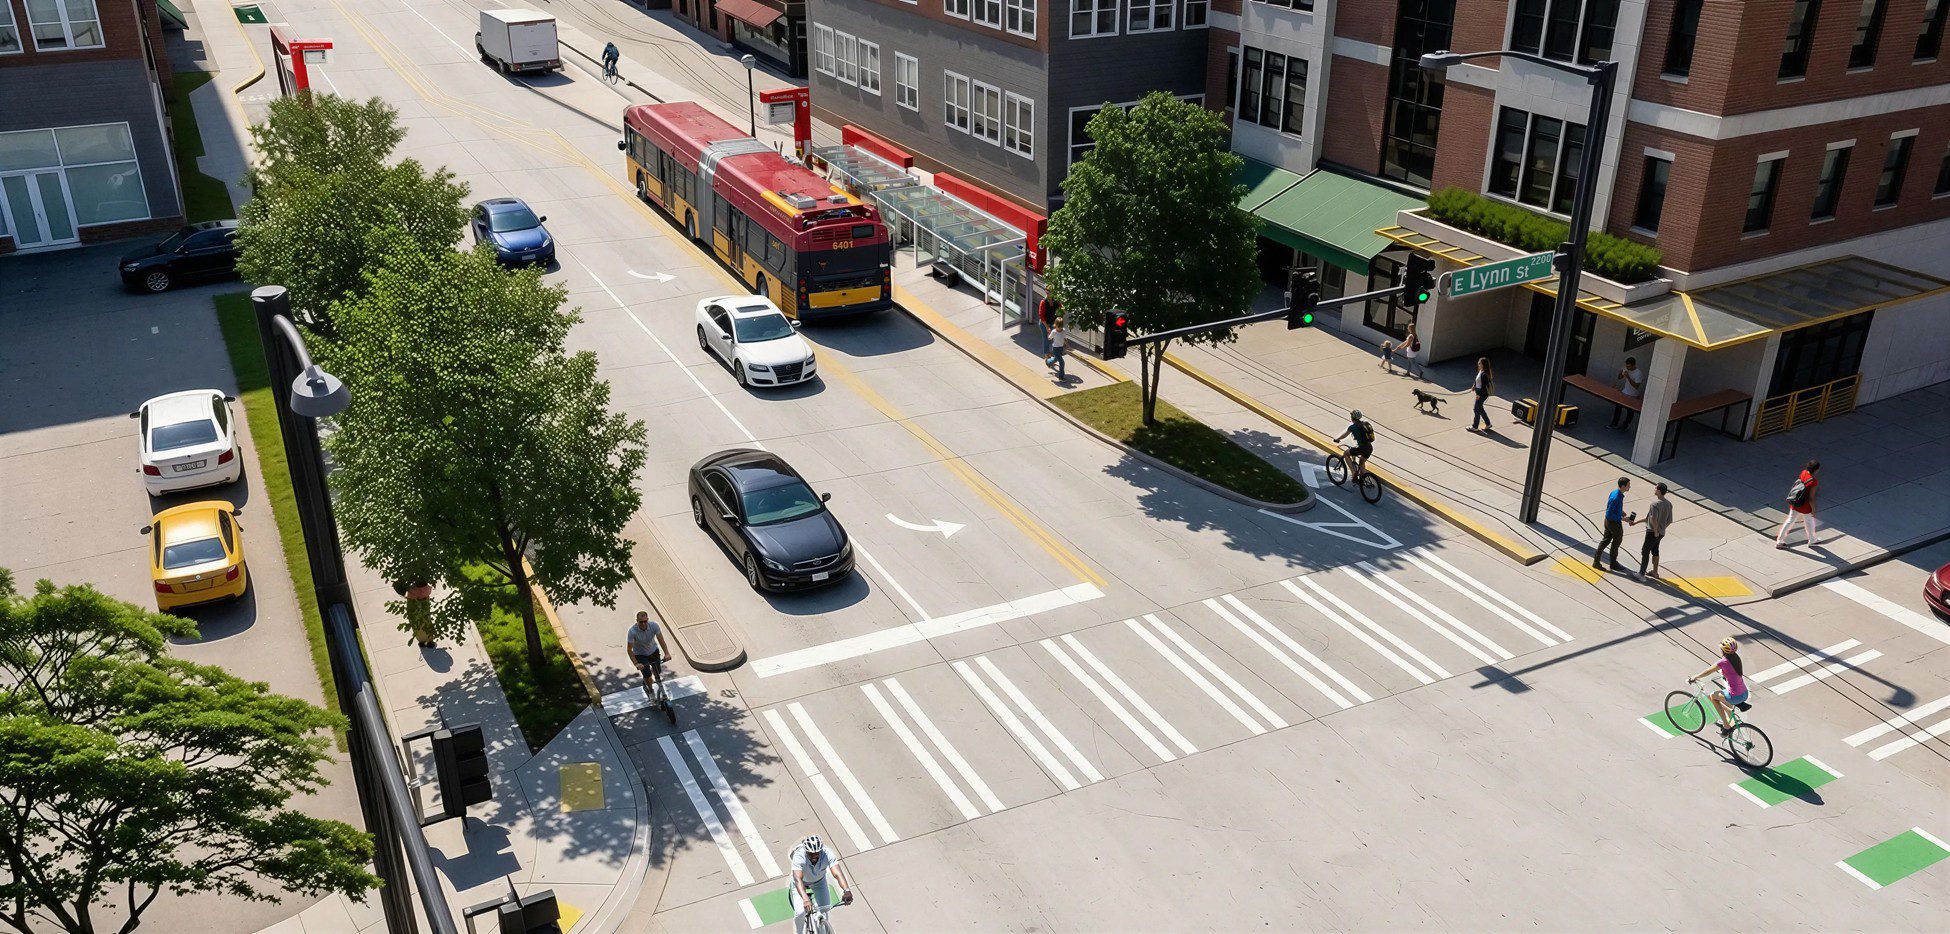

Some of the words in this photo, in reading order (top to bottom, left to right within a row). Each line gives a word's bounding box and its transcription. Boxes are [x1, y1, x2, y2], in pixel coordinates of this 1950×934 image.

[832, 241, 853, 250] 6401
[1531, 254, 1552, 266] 2200
[1454, 278, 1464, 292] E
[1470, 267, 1510, 290] Lynn
[1516, 265, 1530, 279] St
